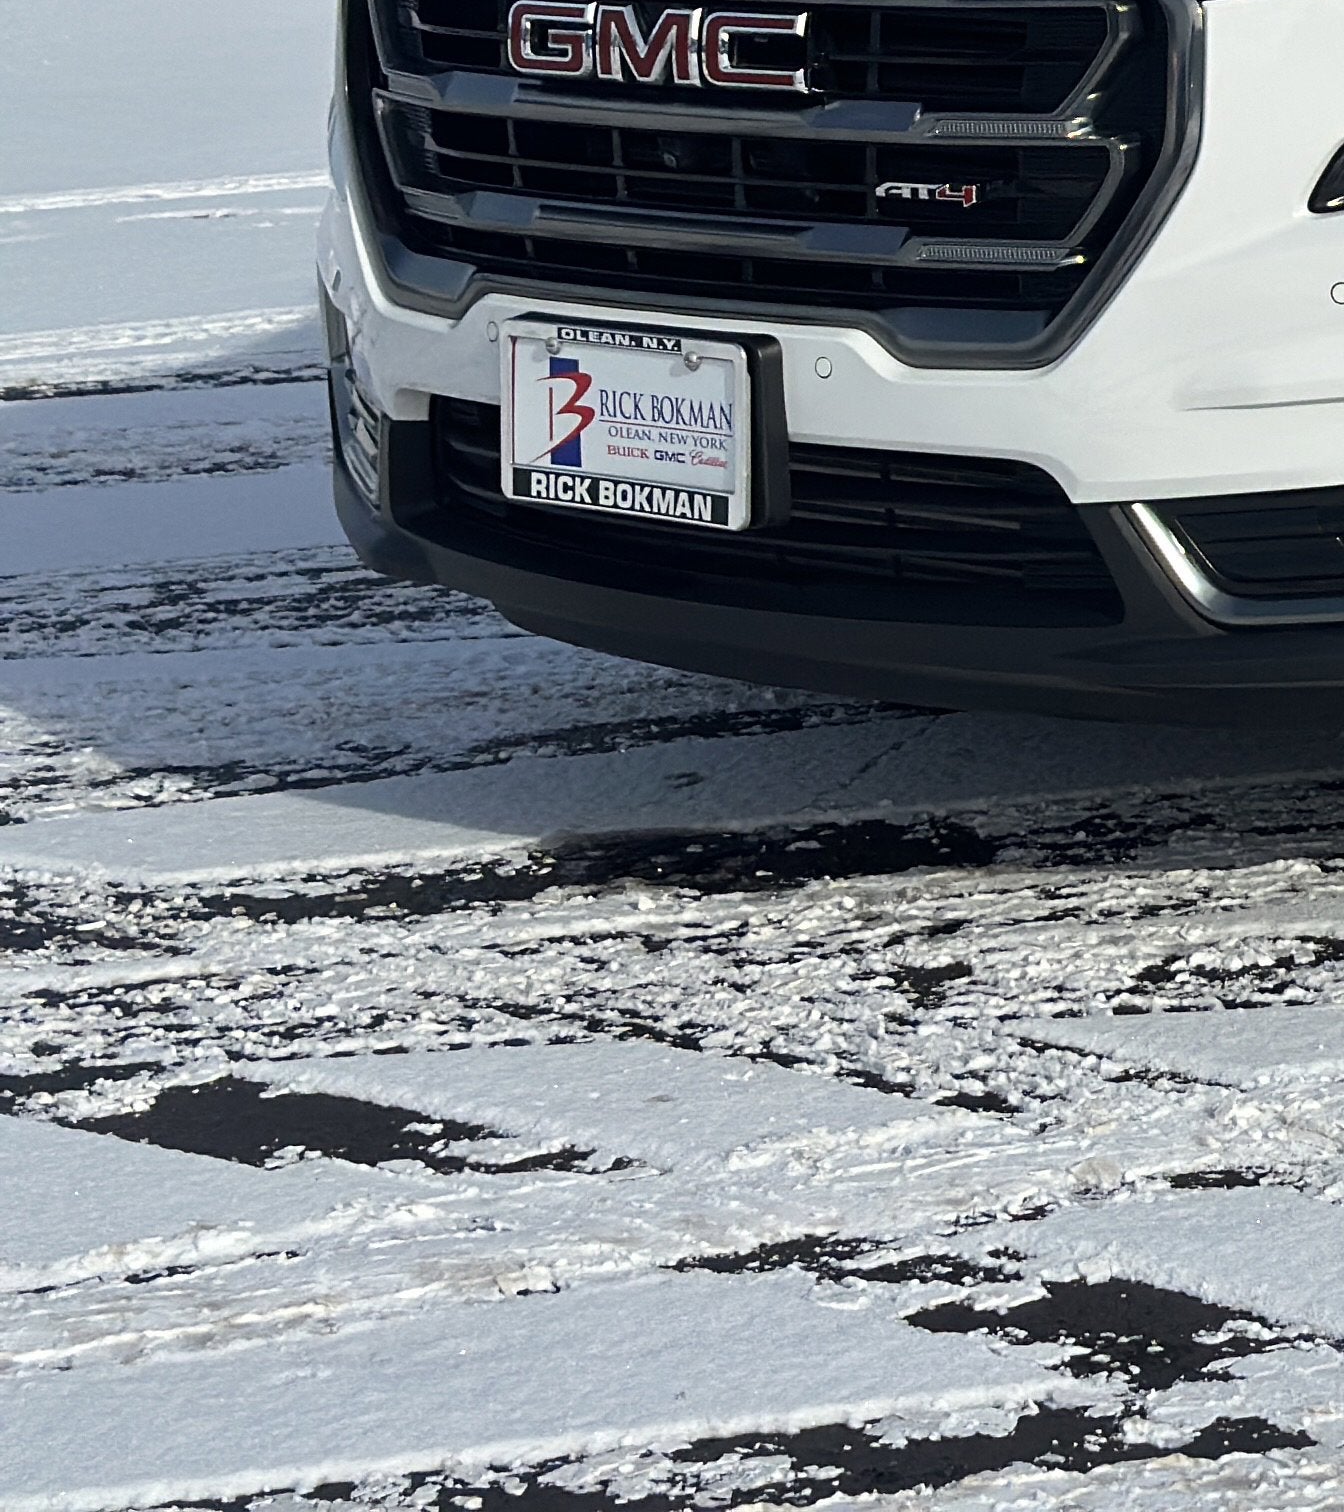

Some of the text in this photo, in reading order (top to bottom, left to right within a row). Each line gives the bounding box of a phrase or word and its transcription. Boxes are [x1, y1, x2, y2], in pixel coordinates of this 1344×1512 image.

[507, 0, 809, 93] GMC
[875, 181, 977, 208] AT4
[642, 336, 678, 351] N.Y.
[599, 389, 733, 432] RICK BOKMAN
[607, 444, 649, 459] BUICK
[654, 449, 685, 464] GMC
[658, 431, 688, 445] NEW
[690, 435, 728, 451] YORK
[530, 471, 712, 521] RICK BOKMAN
